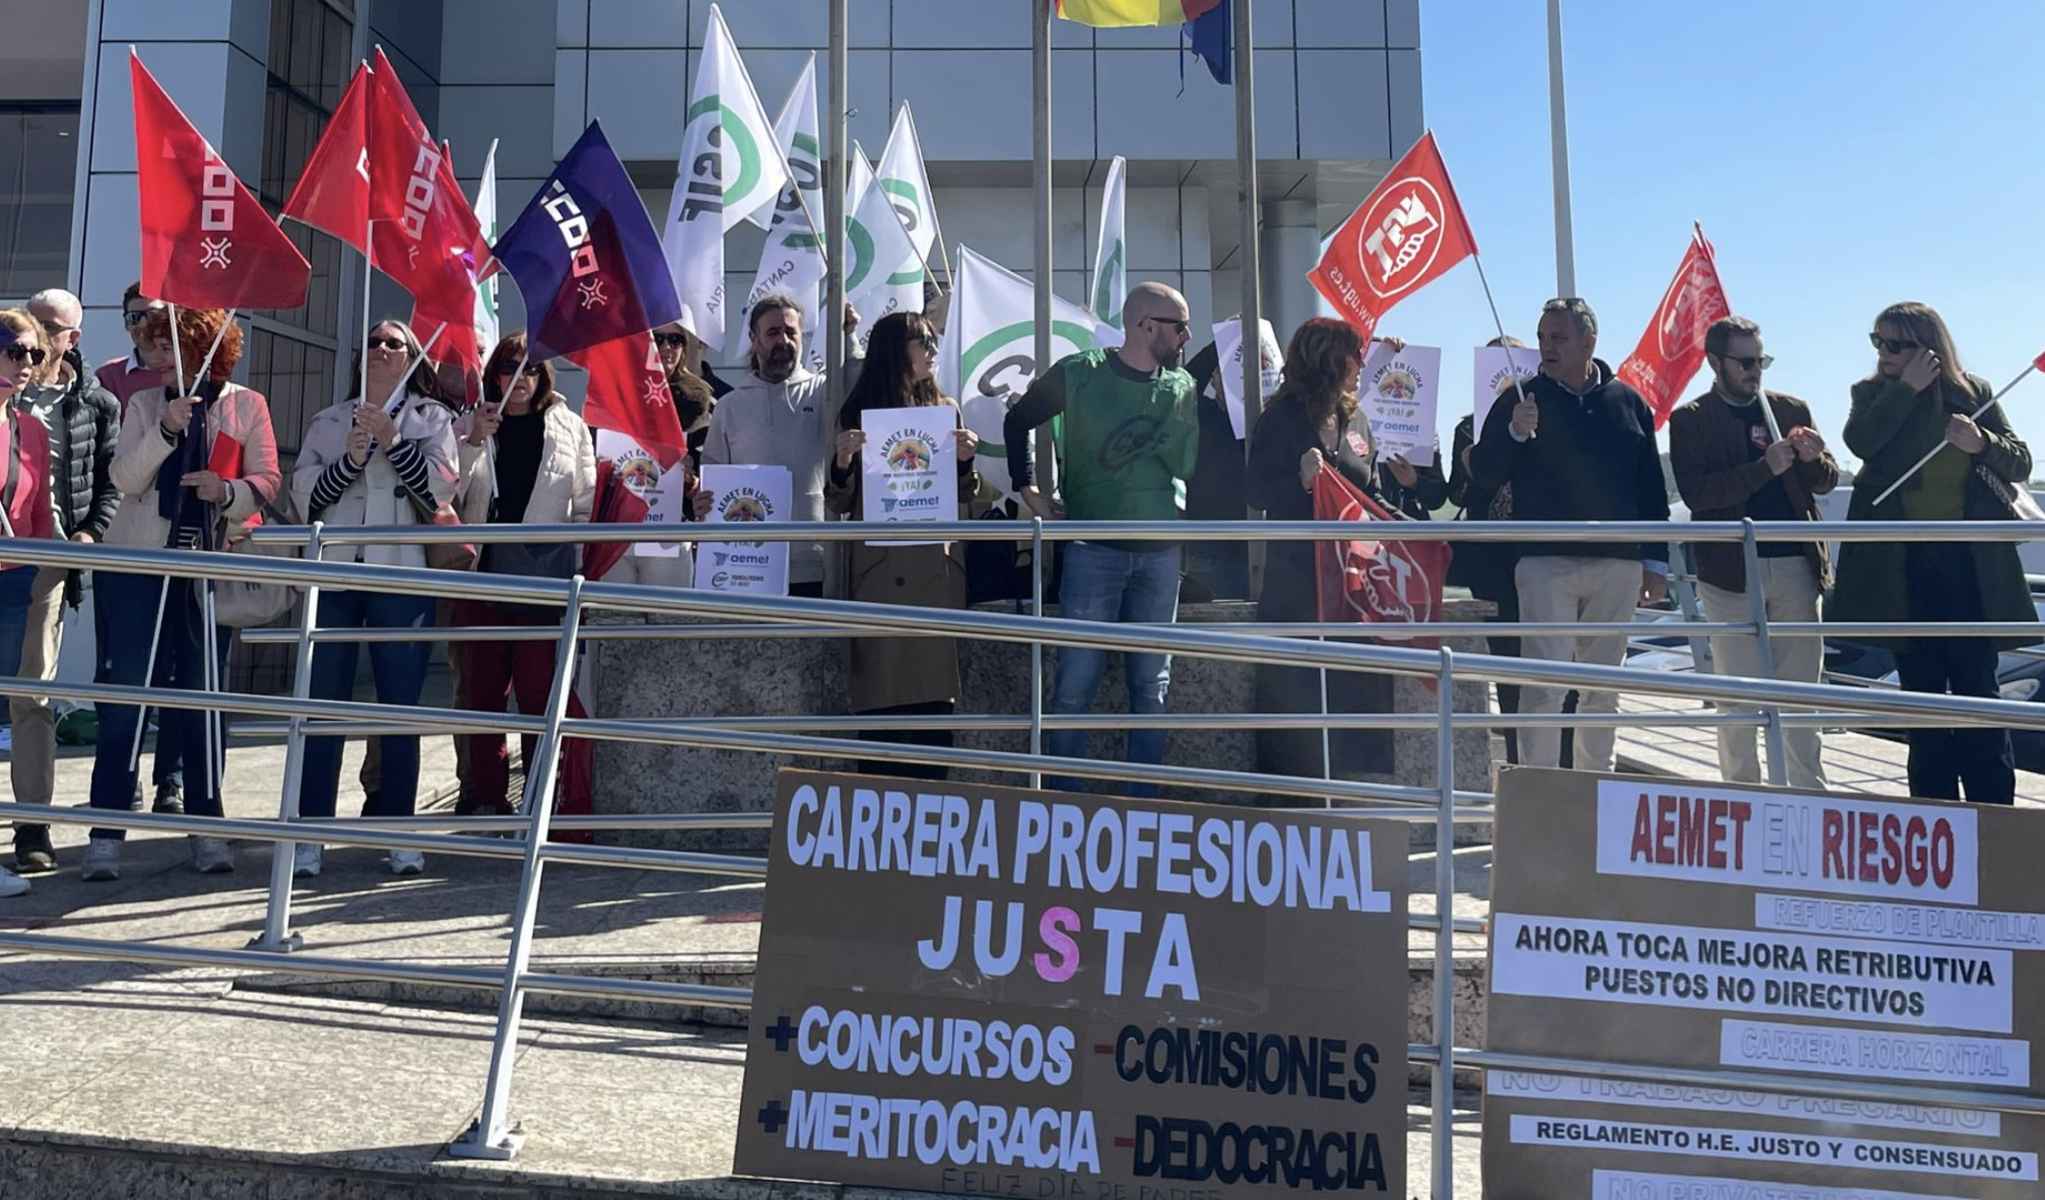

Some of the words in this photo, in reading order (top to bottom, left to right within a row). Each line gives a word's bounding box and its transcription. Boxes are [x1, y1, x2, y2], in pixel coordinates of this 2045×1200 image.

[880, 430, 902, 458] AEMET
[904, 428, 916, 437] EN
[917, 430, 940, 455] LUCHA
[1384, 421, 1420, 433] aemet
[718, 488, 741, 513] AEMET
[742, 487, 754, 496] EN
[899, 496, 939, 508] aemet
[731, 553, 769, 565] aemet
[787, 784, 1000, 879] CARRERA
[1013, 800, 1392, 913] PROFESIONAL
[1630, 793, 1752, 871] AEMET
[1763, 803, 1810, 876] EN
[1822, 808, 1955, 890] RIESGO
[1774, 897, 1888, 934] REFUERZO
[1893, 906, 1921, 936] DE
[1926, 909, 2042, 945] PLANTILLA
[917, 896, 1201, 1001] JUSTA
[1514, 924, 1609, 957] AHORA
[1617, 931, 1689, 963] TOCA
[1699, 937, 1808, 972] MEJORA
[1816, 948, 1996, 987] RETRIBUTIVA
[1585, 966, 1709, 1001] PUESTOS
[1717, 974, 1755, 1005] NO
[1765, 979, 1925, 1018] DIRECTIVOS
[1741, 1026, 1852, 1066] CARRERA
[1858, 1034, 2010, 1078] HORIZONTAL
[1537, 1121, 1689, 1148] REGLAMENTO
[1697, 1131, 1741, 1152] H.E.
[1748, 1135, 1821, 1159] JUSTO
[1827, 1141, 1843, 1159] Y
[1854, 1144, 2022, 1174] CONSENSUADO
[942, 1168, 1023, 1195] FELIZ
